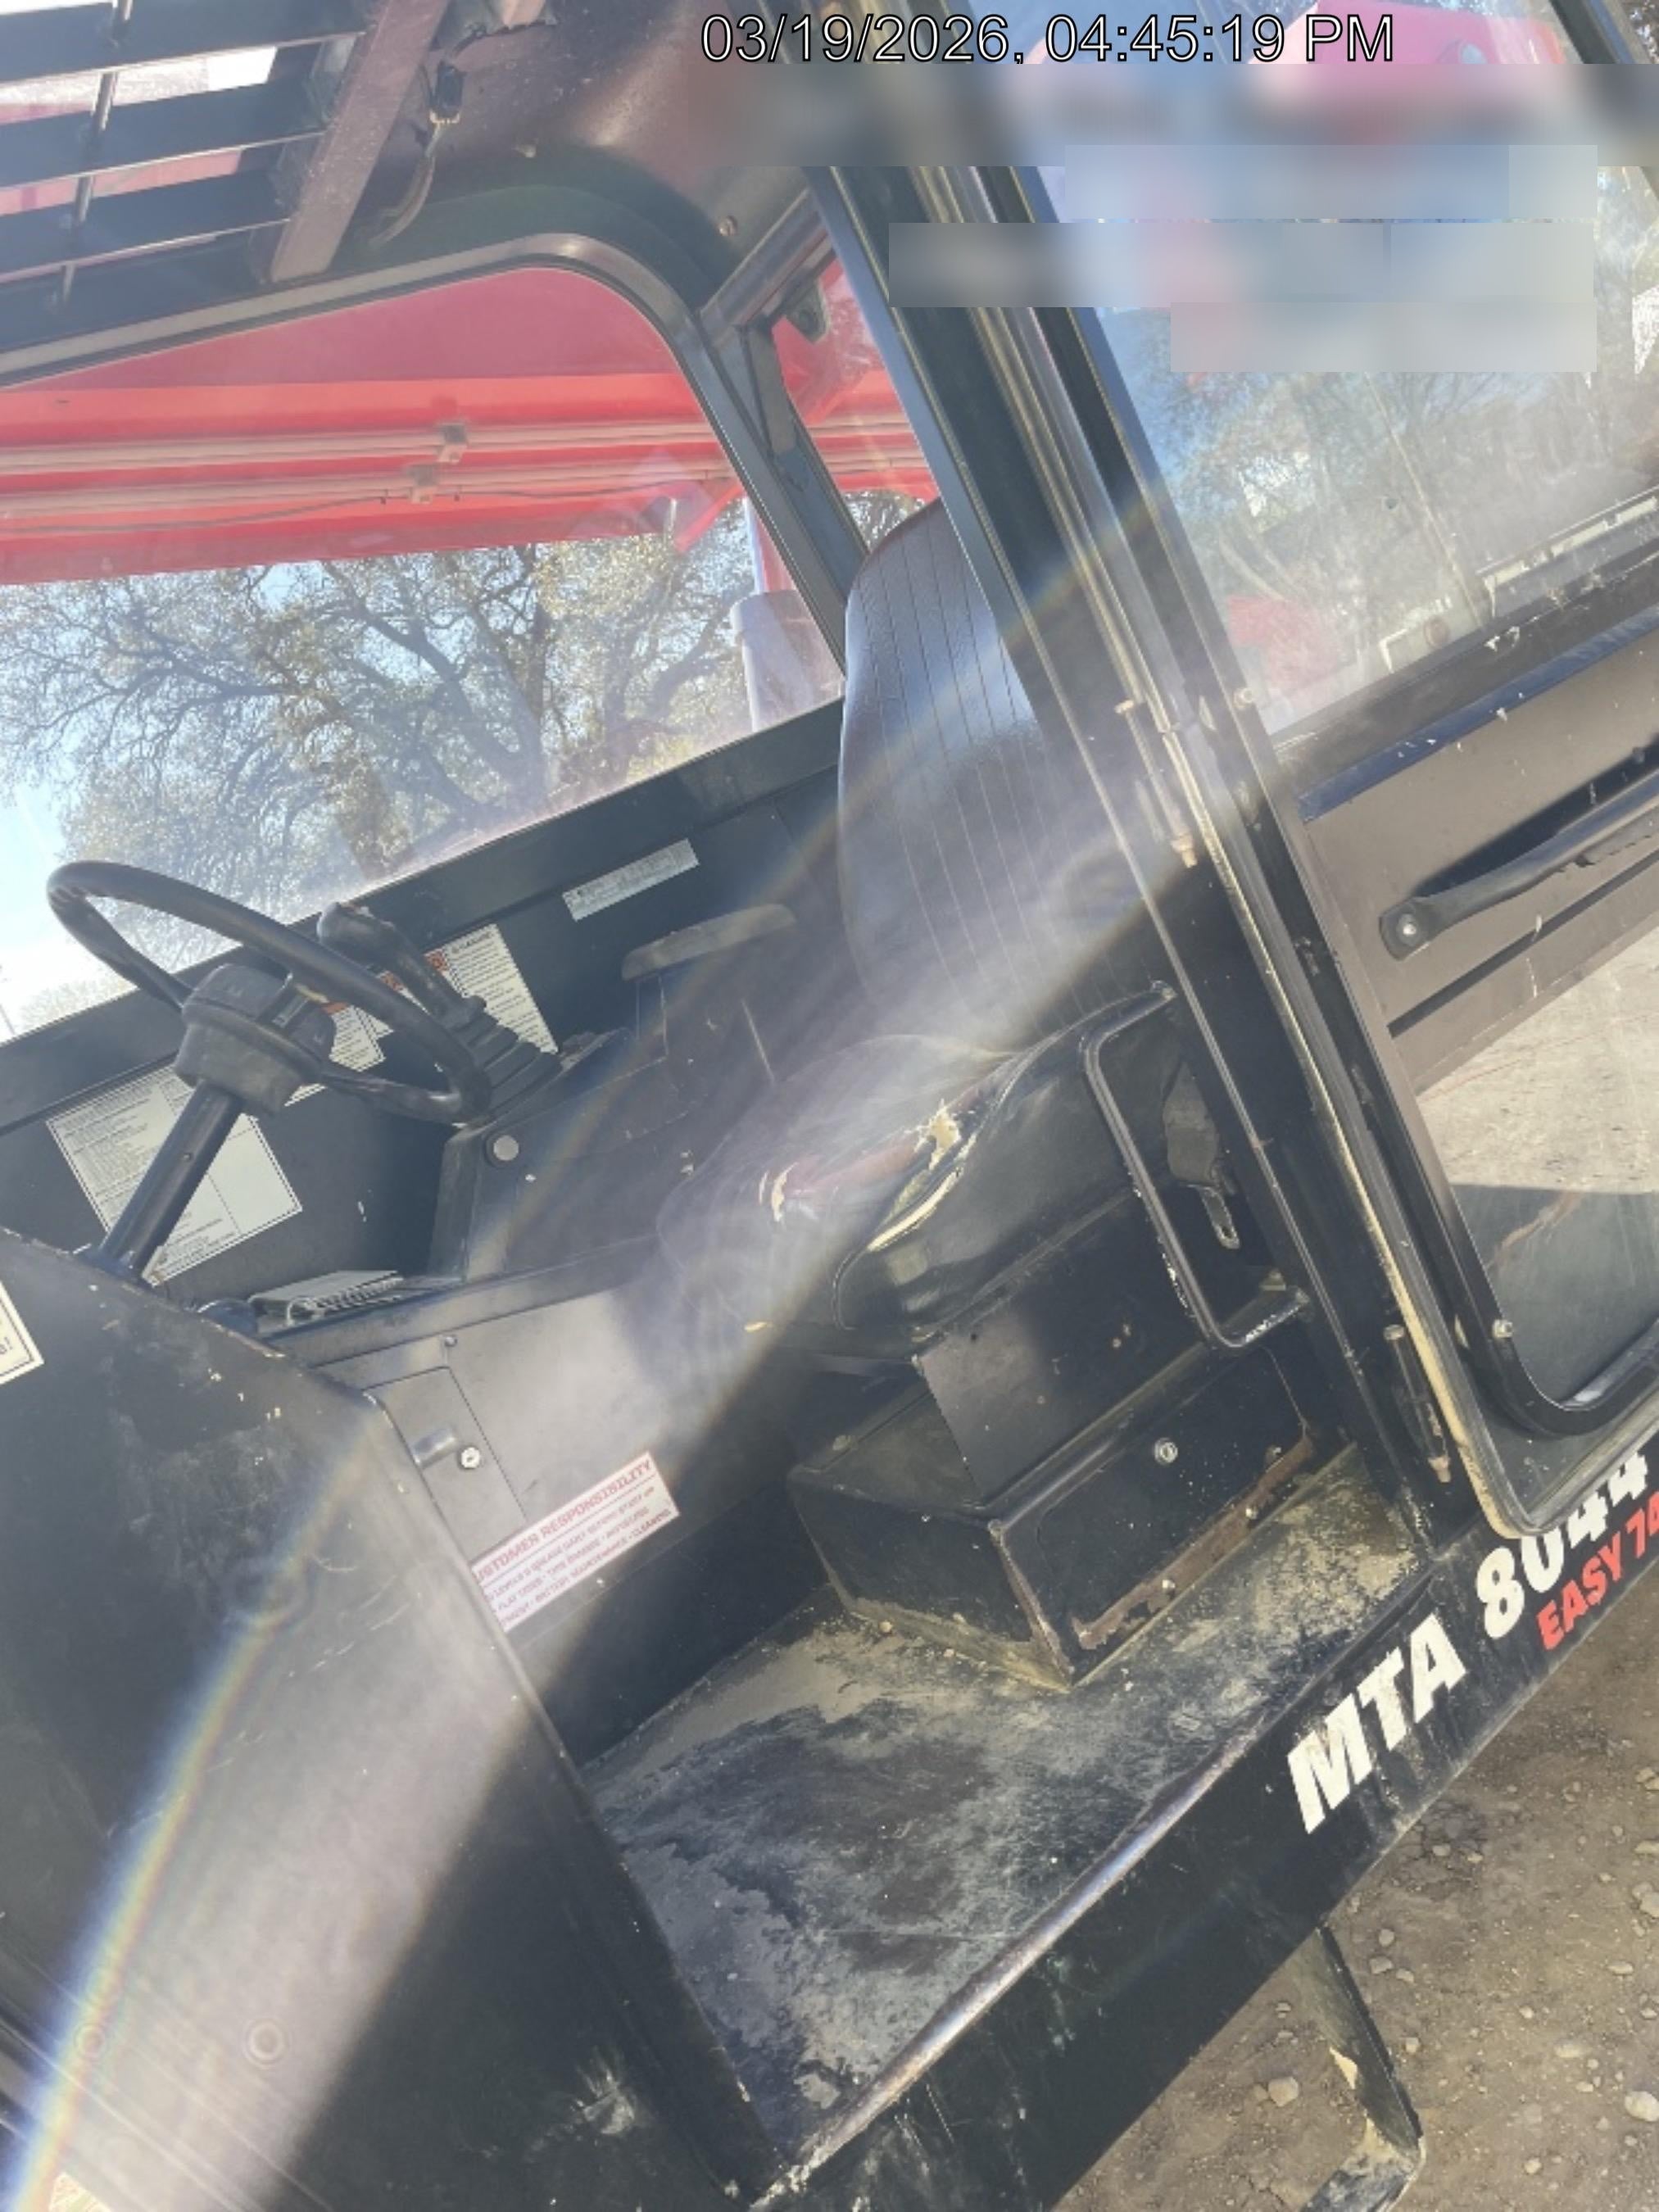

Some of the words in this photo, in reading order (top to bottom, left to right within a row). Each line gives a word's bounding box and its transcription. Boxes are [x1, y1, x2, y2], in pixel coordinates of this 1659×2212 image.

[473, 1532, 540, 1585] USTOMER
[540, 1458, 652, 1539] RESPONSIBILITY
[1287, 1613, 1467, 1835] MTA
[1476, 1451, 1648, 1639] 8044
[1535, 1530, 1625, 1652] EASY
